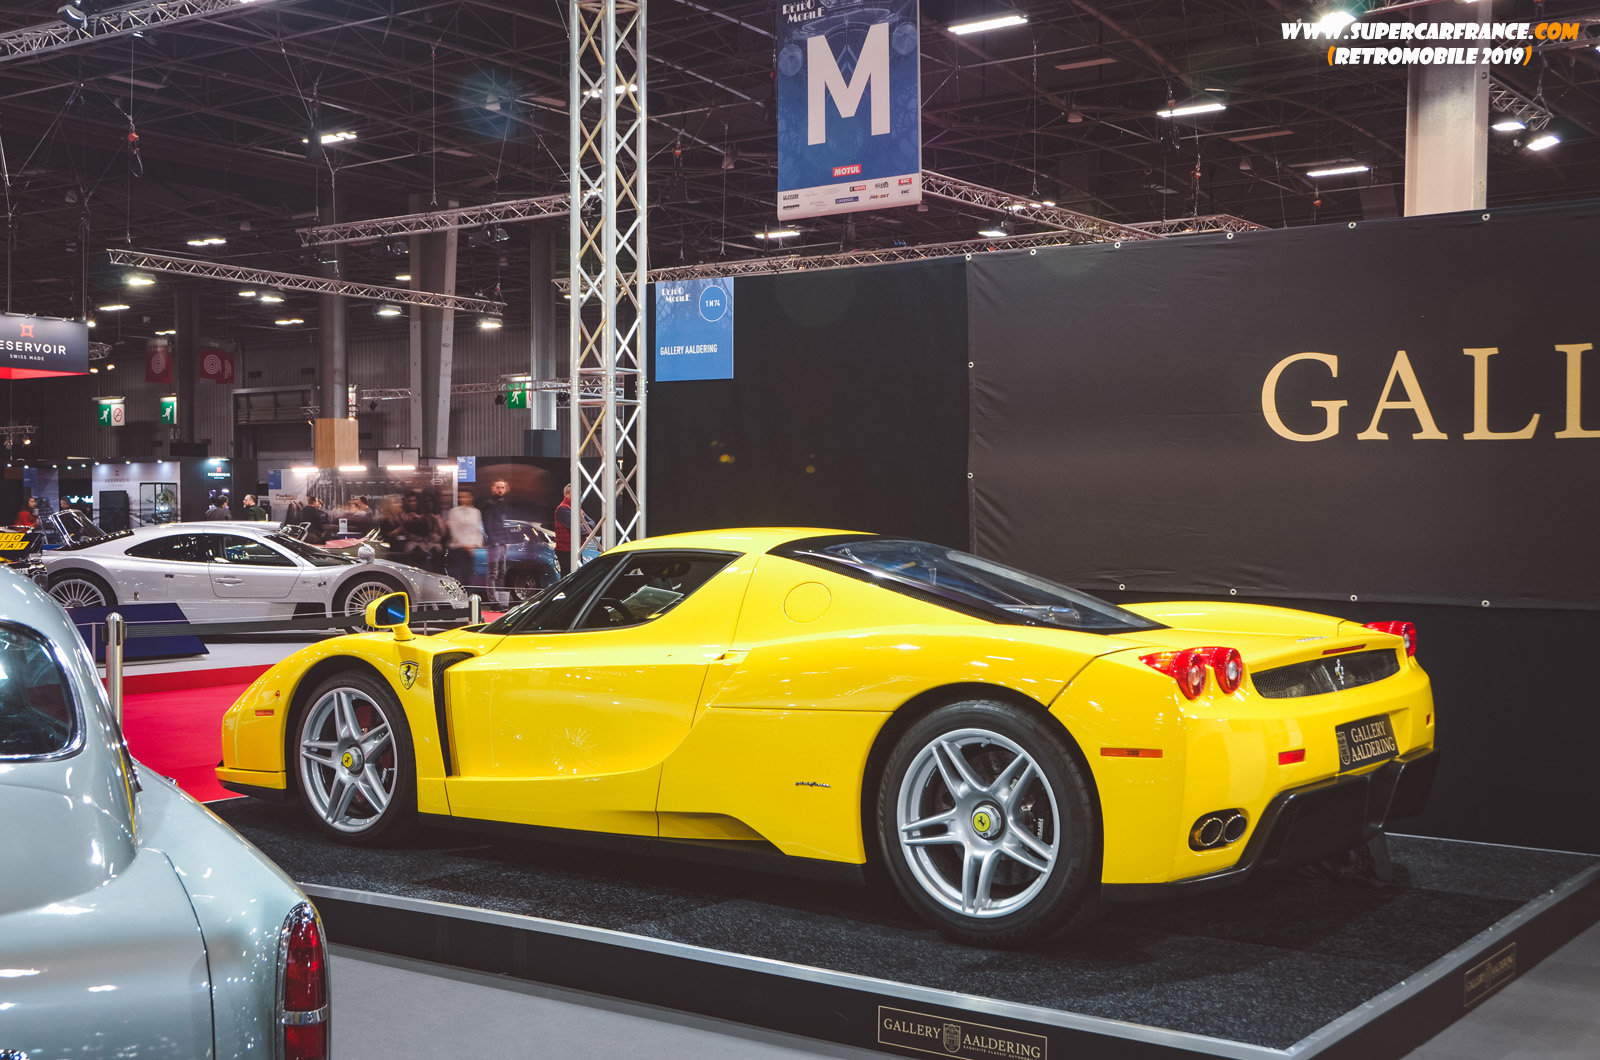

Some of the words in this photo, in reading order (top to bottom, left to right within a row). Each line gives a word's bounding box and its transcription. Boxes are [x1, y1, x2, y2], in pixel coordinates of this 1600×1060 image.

[807, 22, 890, 146] M
[834, 165, 860, 176] MOTUL
[660, 345, 684, 356] GALLERY
[685, 344, 718, 354] AALDERING
[1261, 343, 1600, 442] GALL
[1350, 720, 1387, 743] GALLERY
[1351, 736, 1396, 762] AALDERING
[883, 1018, 941, 1039] GALLERY
[963, 1033, 1041, 1059] AALDERING
